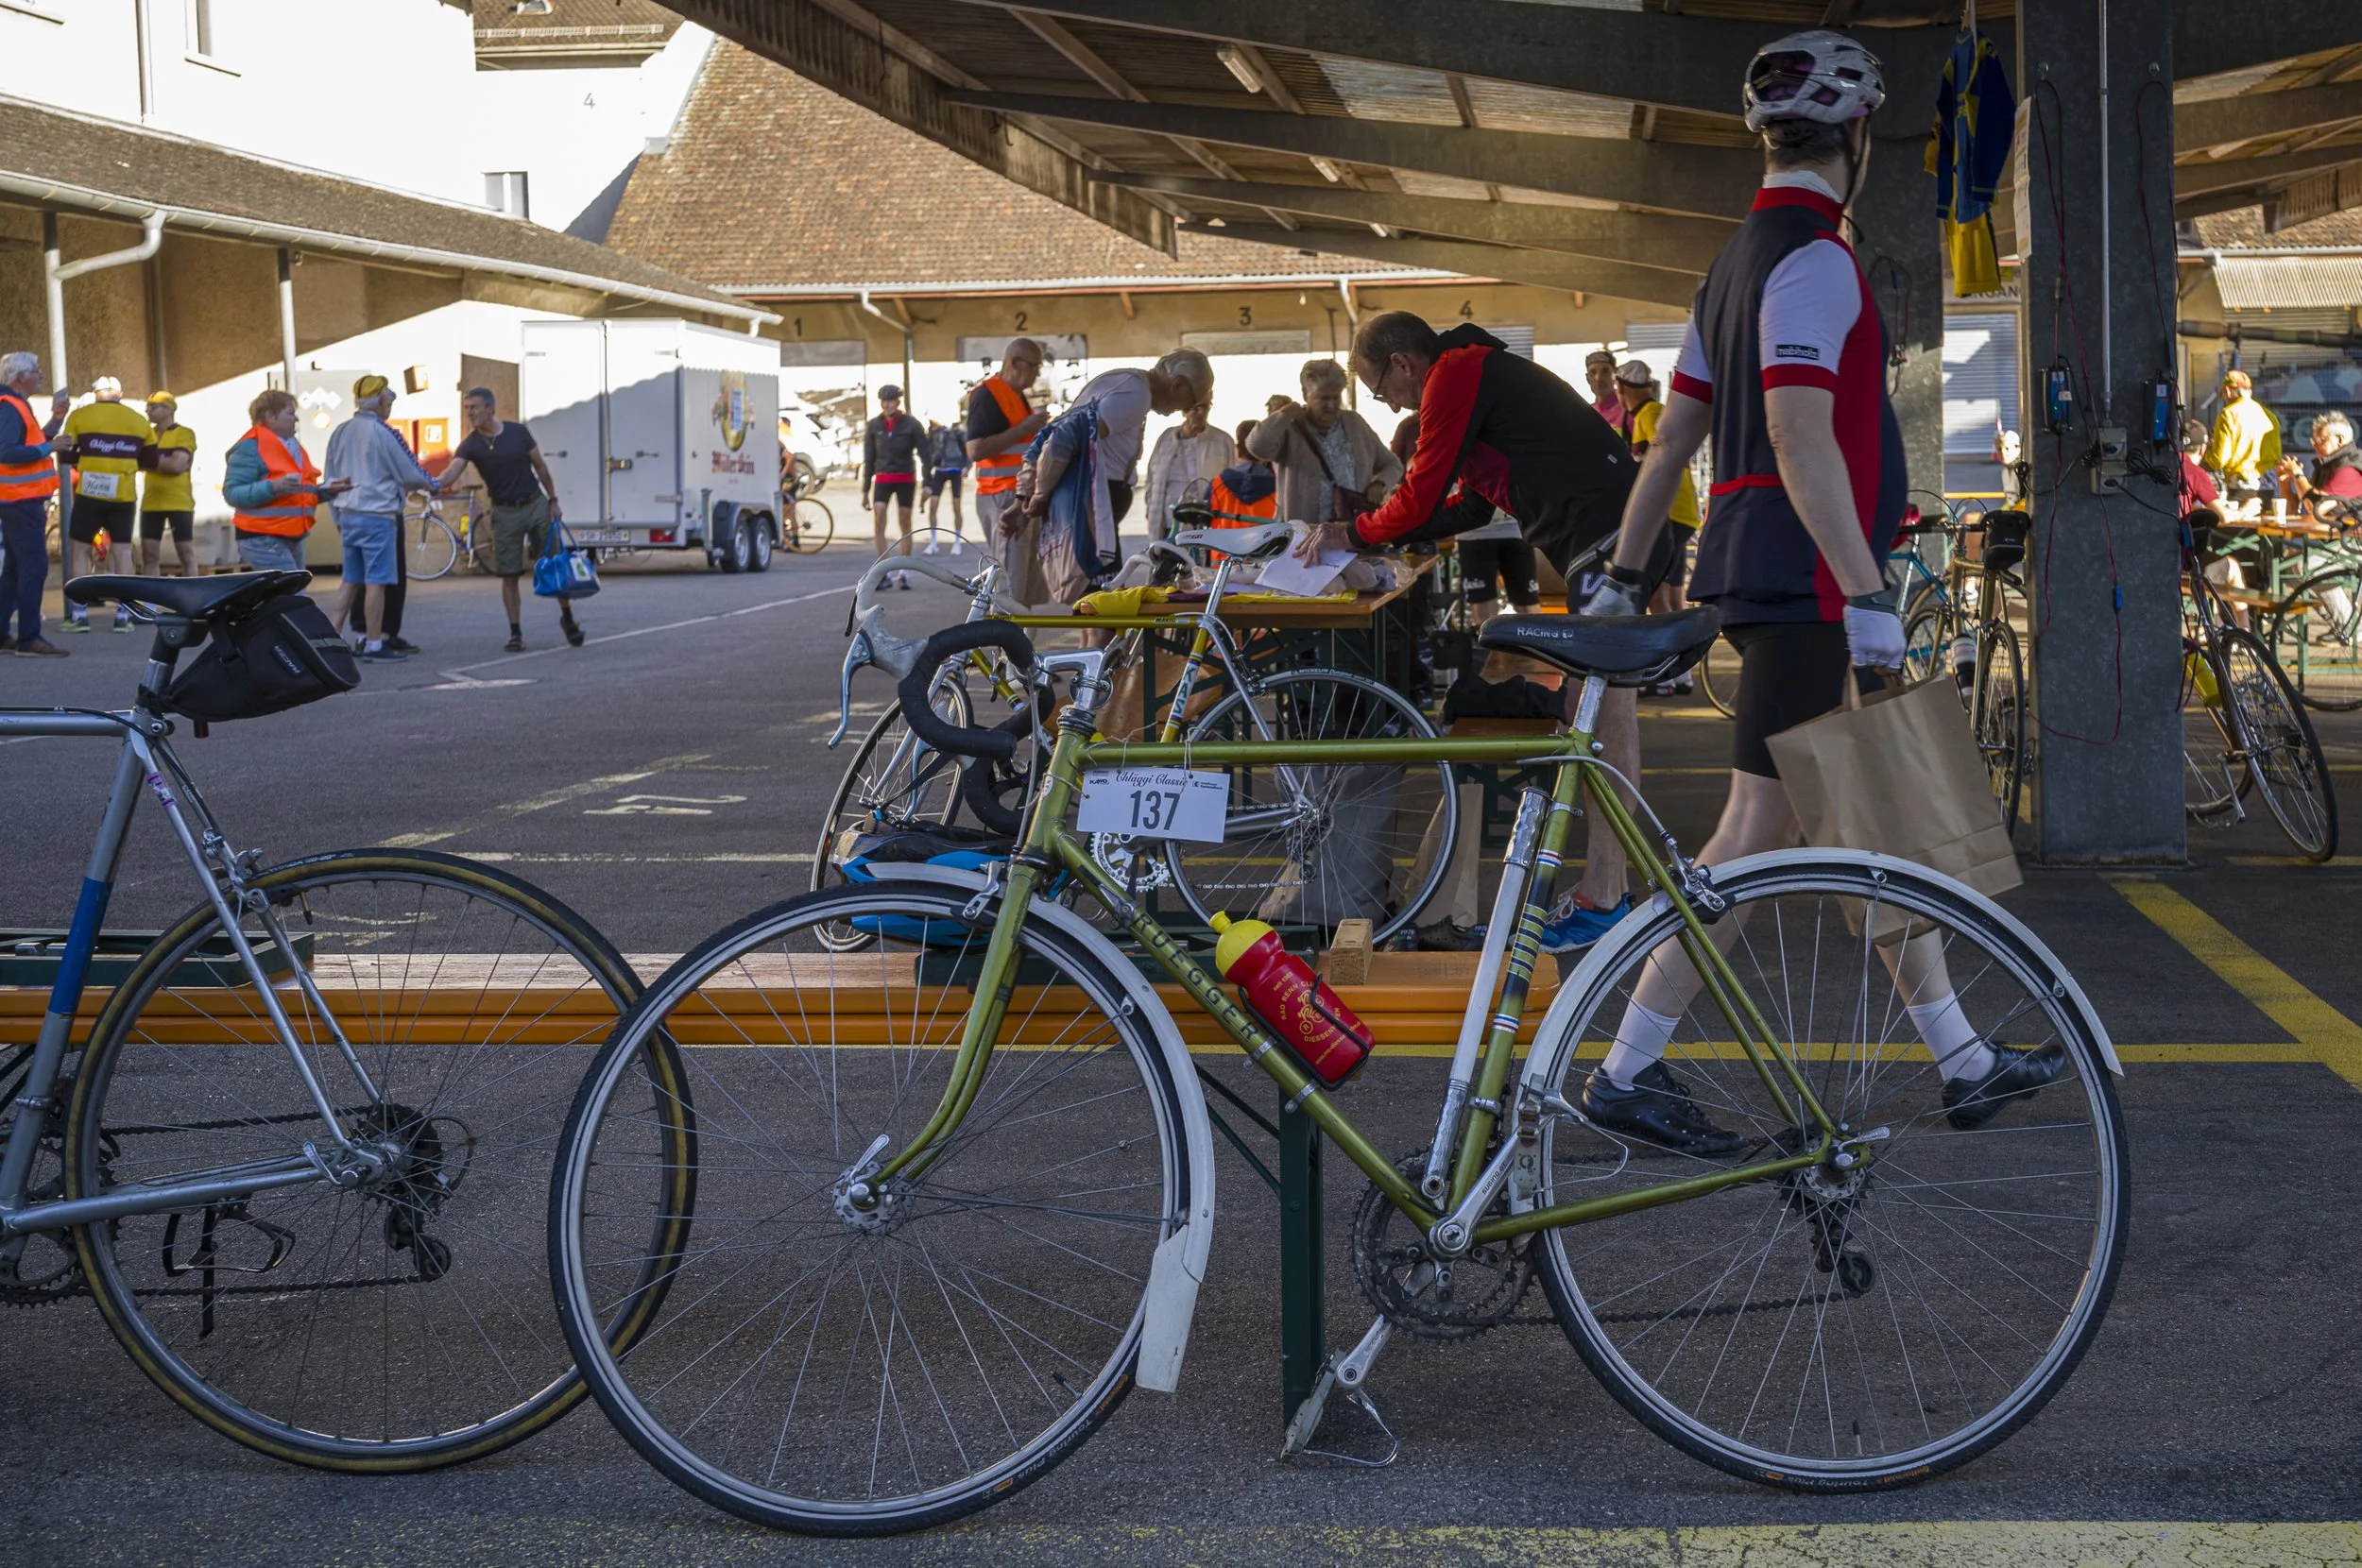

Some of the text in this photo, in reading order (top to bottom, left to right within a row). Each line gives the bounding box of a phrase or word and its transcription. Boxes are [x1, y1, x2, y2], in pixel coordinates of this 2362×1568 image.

[1239, 306, 1252, 326] 3
[1460, 299, 1473, 320] 4
[795, 317, 803, 337] 1
[1015, 311, 1028, 332] 2
[1516, 626, 1559, 639] RACING
[1172, 667, 1195, 714] KAS
[1116, 771, 1153, 787] Chläggi
[1155, 774, 1188, 786] Classic
[1130, 790, 1181, 831] 137
[1135, 913, 1258, 1040] RUEGGER
[1281, 983, 1299, 1002] RENN
[1481, 1170, 1500, 1195] SUGINO
[1049, 1418, 1093, 1457] Touring
[1017, 1457, 1046, 1479] Plus
[1787, 1476, 1814, 1486] Plus
[1818, 1478, 1869, 1488] Touring
